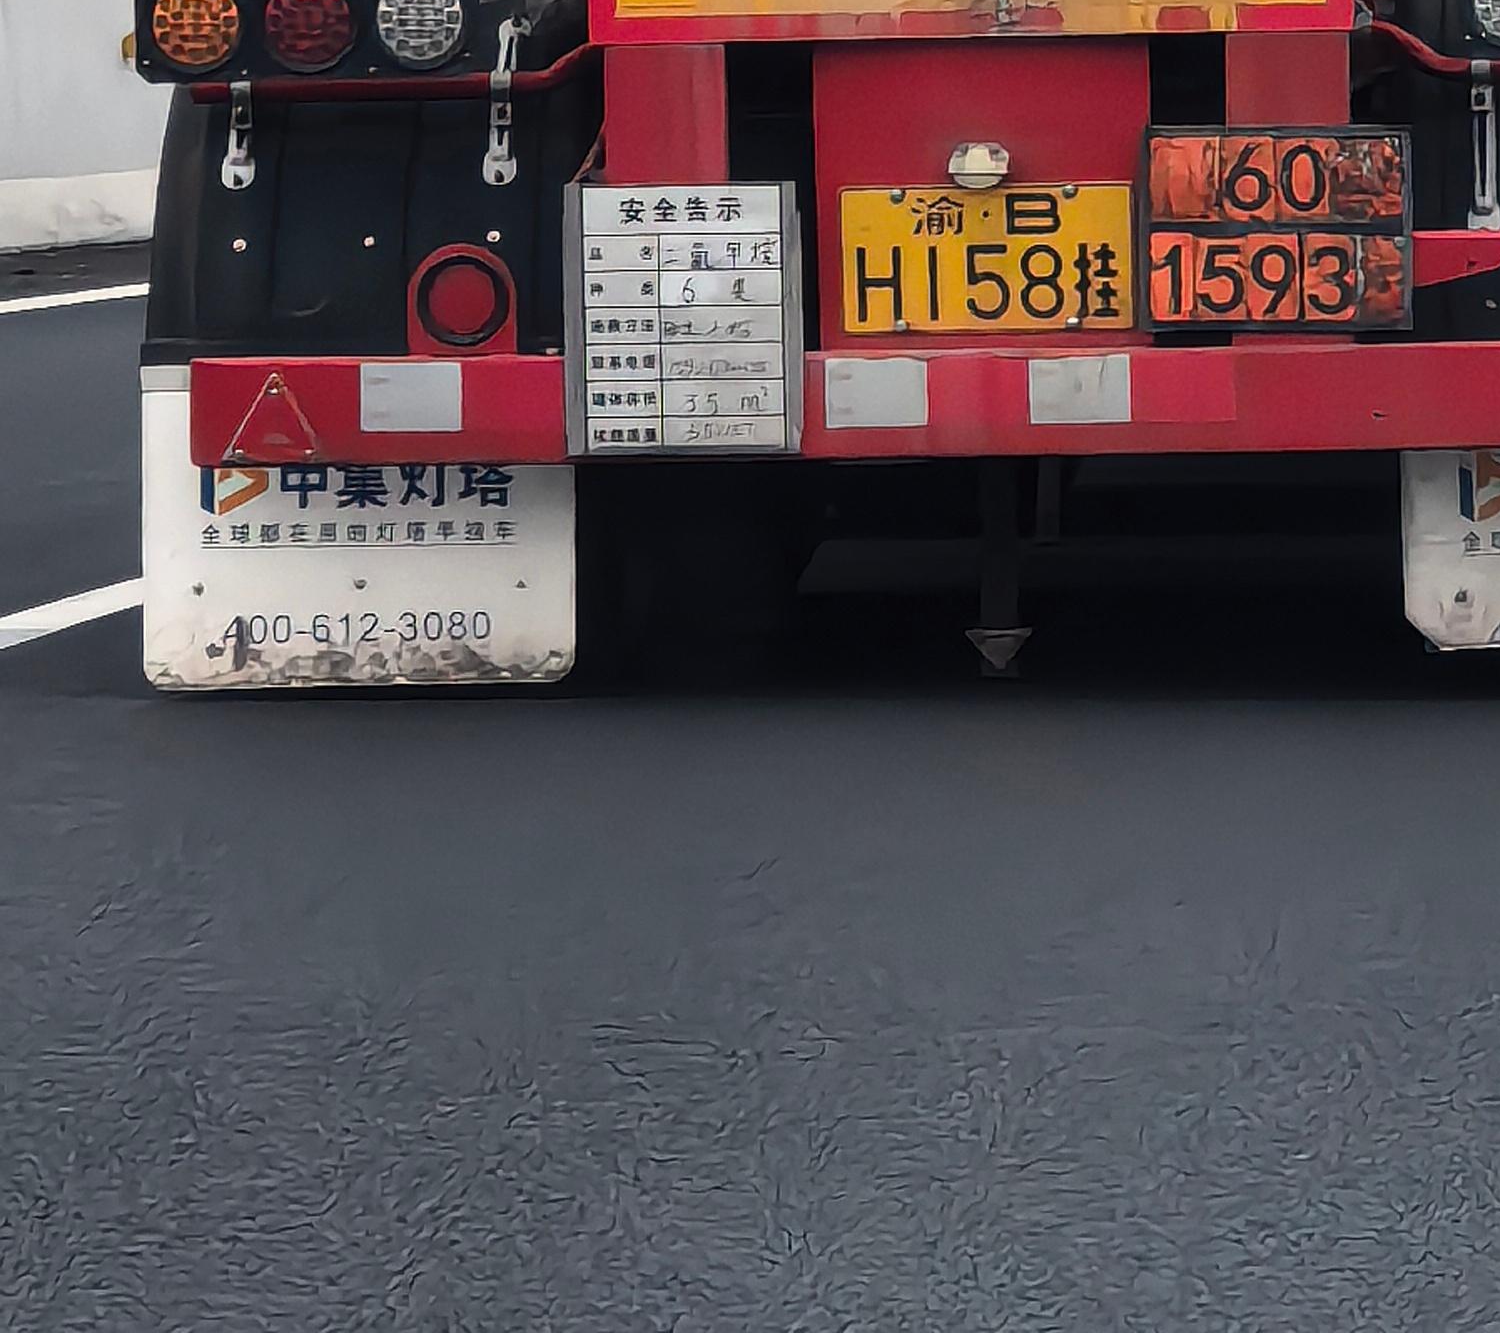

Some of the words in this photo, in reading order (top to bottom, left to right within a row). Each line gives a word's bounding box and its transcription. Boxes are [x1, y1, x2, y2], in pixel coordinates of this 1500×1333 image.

[1224, 141, 1326, 213] 60
[619, 196, 743, 225] 安全告示
[1150, 243, 1357, 316] 1593
[280, 464, 515, 509] 中集灯塔
[223, 610, 493, 646] 400-612-3080
